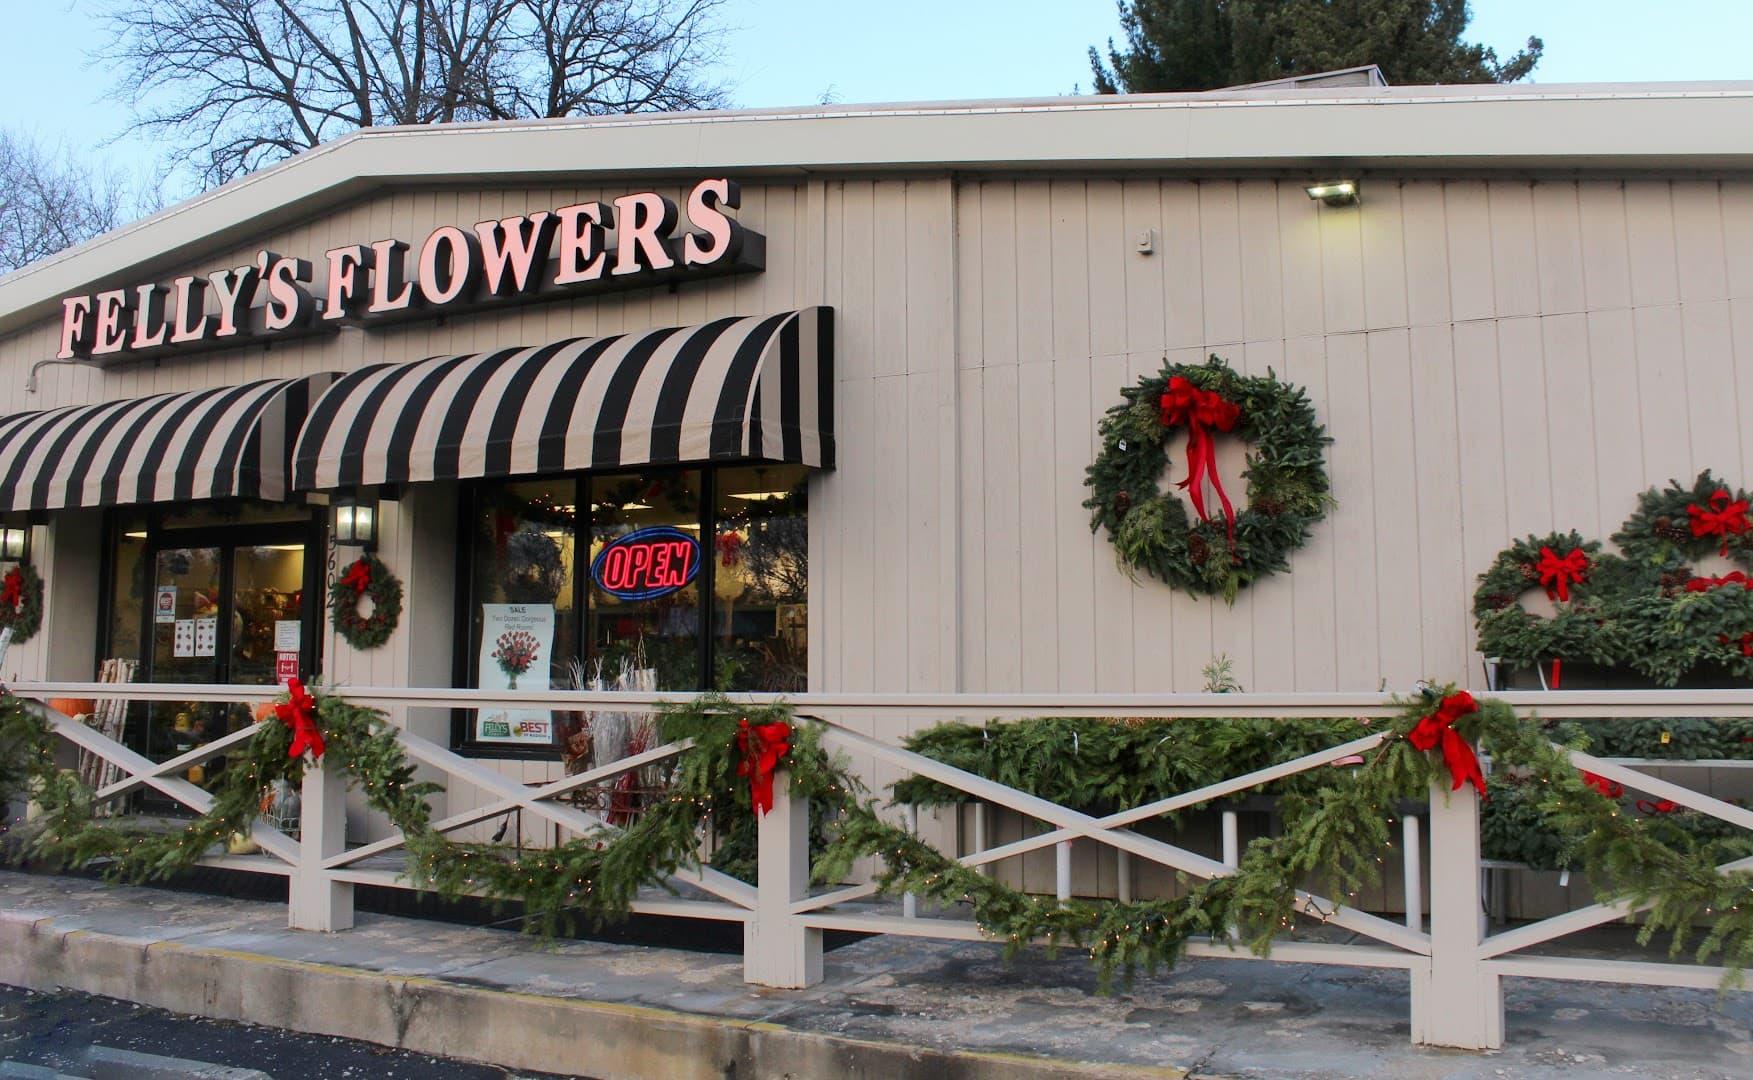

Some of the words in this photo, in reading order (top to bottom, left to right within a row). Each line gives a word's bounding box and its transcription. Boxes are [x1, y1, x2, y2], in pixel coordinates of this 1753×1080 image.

[57, 251, 300, 360] FELLY'S
[322, 178, 731, 320] FLOWERS
[326, 535, 337, 608] 5602
[604, 541, 691, 590] OPEN
[520, 722, 549, 733] BEST
